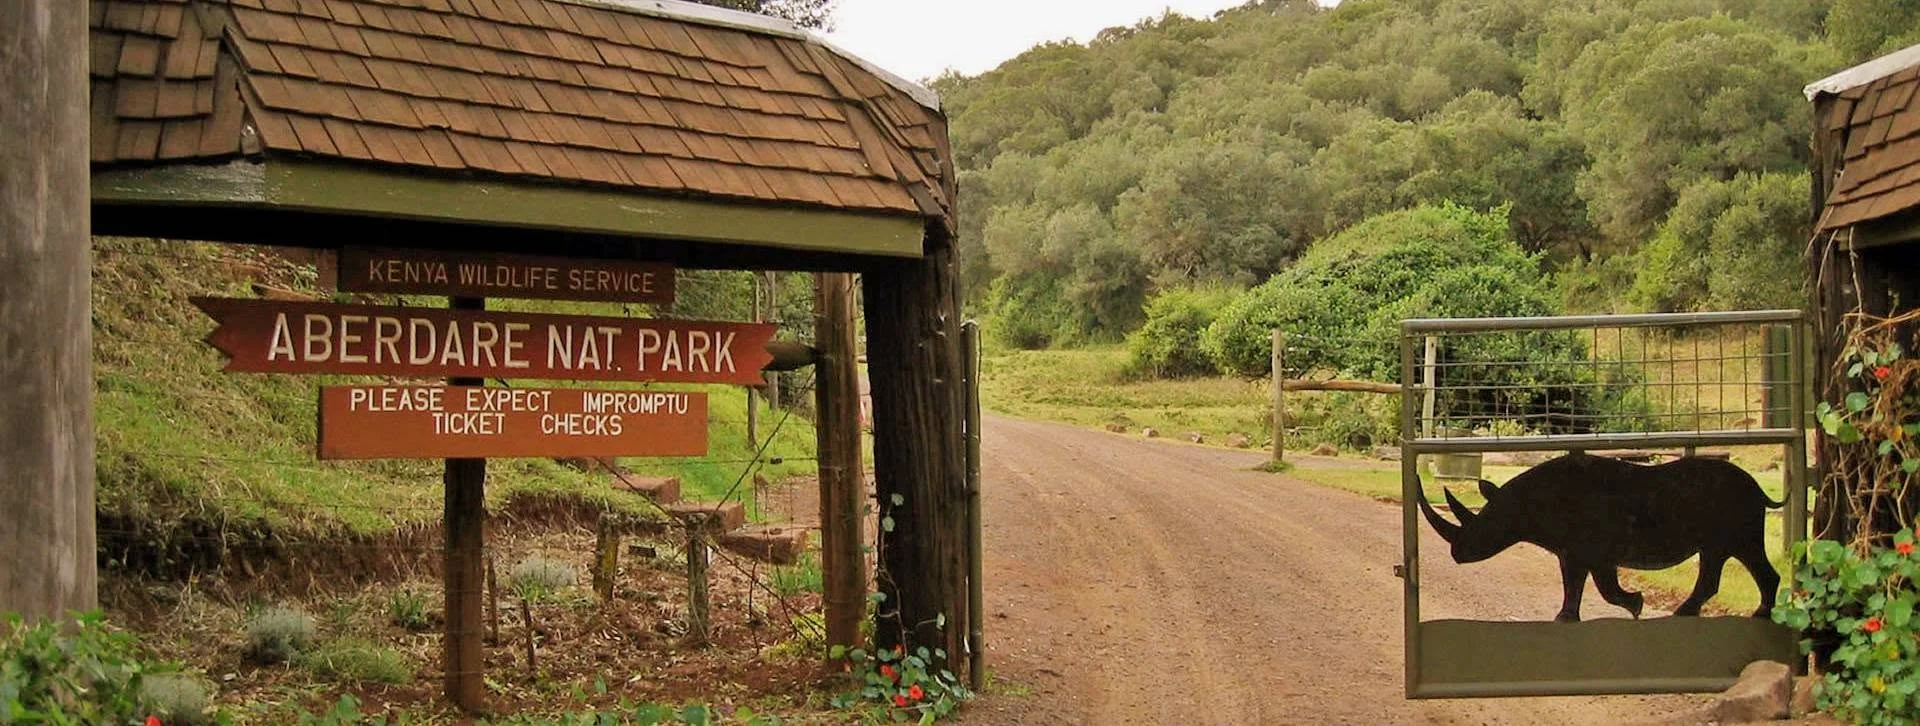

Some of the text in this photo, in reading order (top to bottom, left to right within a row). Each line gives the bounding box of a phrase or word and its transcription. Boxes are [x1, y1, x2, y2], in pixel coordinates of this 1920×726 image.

[369, 259, 655, 293] KENYA WILDLIFE SERVICE
[267, 312, 737, 373] ABERDARE NAT. PARK
[350, 388, 688, 414] PLEASE EXPECT IMPROMPTU
[432, 412, 623, 436] TICKET CHECKS
